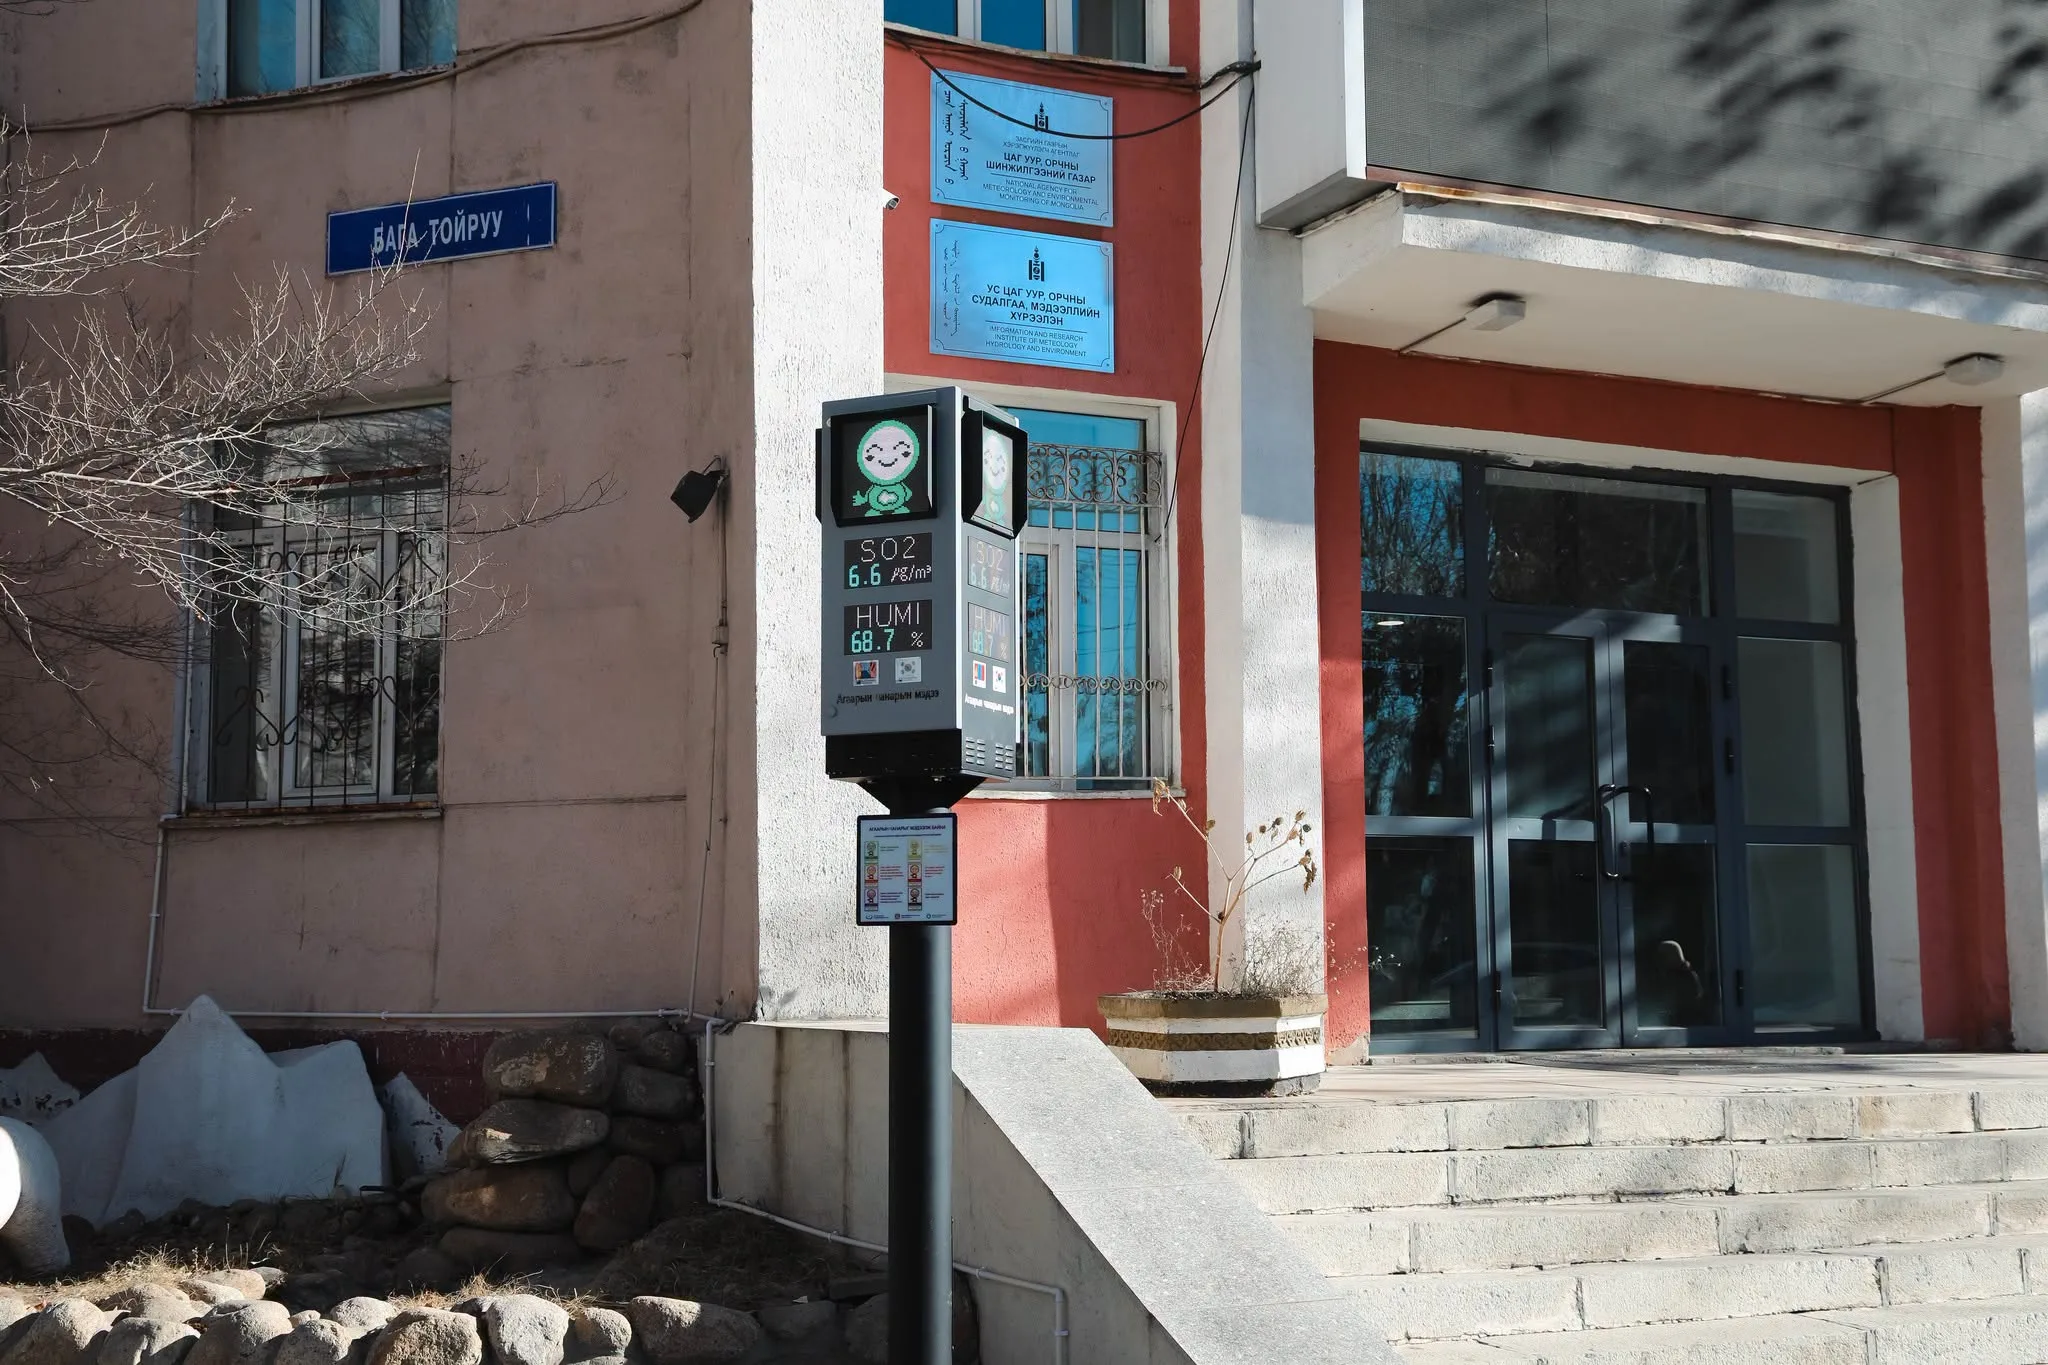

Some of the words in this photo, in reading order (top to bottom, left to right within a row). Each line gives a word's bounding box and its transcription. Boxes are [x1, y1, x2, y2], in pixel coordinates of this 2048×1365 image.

[986, 160, 1066, 180] ШИНЖИЛГЭЭНИЙ
[1068, 172, 1096, 184] ГАЗАР
[1004, 152, 1022, 162] ЦАГ
[1024, 155, 1042, 167] УУР,
[1045, 159, 1079, 171] ОРЧНЫ
[983, 183, 1031, 196] METEOROLOGY
[1032, 189, 1046, 197] AND
[1047, 191, 1099, 206] ENVIRONMENTAL
[1005, 179, 1036, 190] NATIONAL
[1036, 184, 1063, 193] AGENCY
[1064, 187, 1078, 195] FOR
[999, 193, 1040, 205] MONITORING
[1041, 197, 1049, 205] OF
[1049, 199, 1084, 211] MONGOLIA
[373, 222, 418, 254] БАГА
[429, 209, 503, 245] ТОЙРУУ
[987, 284, 1000, 294] УС
[1003, 286, 1023, 297] ЦАГ
[1025, 289, 1046, 301] УУР,
[1048, 292, 1086, 305] ОРЧНЫ
[971, 294, 1028, 311] СУДАЛГАА,
[1030, 301, 1100, 319] МЭДЭЭЛЛИЙН
[1010, 311, 1063, 326] ХҮРЭЭЛЭН
[990, 325, 1034, 336] INFORMATION
[1034, 330, 1048, 338] AND
[1049, 331, 1084, 342] RESEARCH
[994, 334, 1027, 344] INSTITUTE
[985, 340, 1026, 351] HYDROLOGY
[1026, 344, 1041, 352] AND
[1042, 346, 1087, 357] ENVIRONMENT
[861, 536, 915, 563] SO2
[849, 563, 881, 588] 6.6
[857, 602, 920, 628] HUMI
[851, 628, 895, 653] 68.7
[911, 631, 924, 647] %
